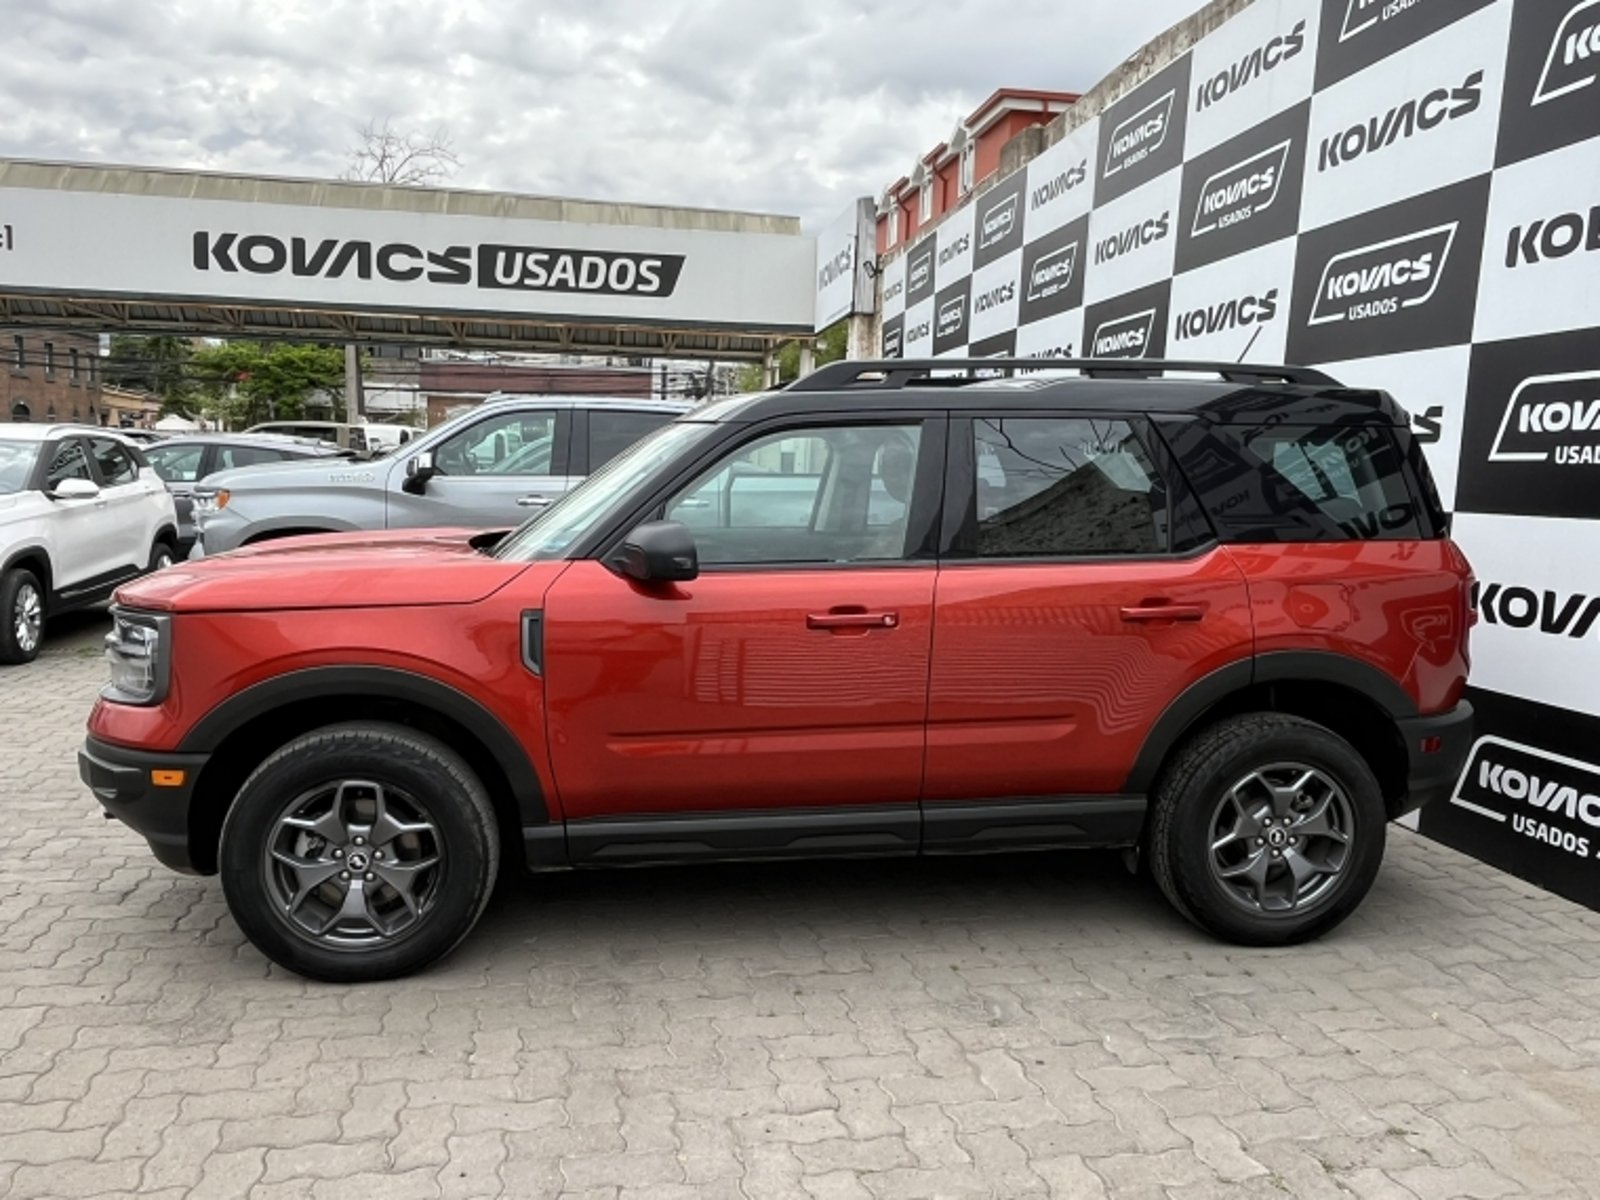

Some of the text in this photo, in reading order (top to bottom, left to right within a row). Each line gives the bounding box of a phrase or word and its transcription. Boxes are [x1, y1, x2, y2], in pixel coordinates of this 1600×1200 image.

[1196, 19, 1306, 112] KOVACS
[1113, 112, 1164, 158] KOVACS
[1318, 69, 1484, 173] KOVACS
[1204, 166, 1274, 215] KOVACS
[193, 231, 662, 293] KOVACS USADOS
[1095, 210, 1170, 265] KOVACS
[1327, 252, 1432, 300] KOVACS
[1175, 288, 1278, 341] KOVACS
[1349, 297, 1397, 320] USADOS
[1513, 813, 1590, 857] USADOS
